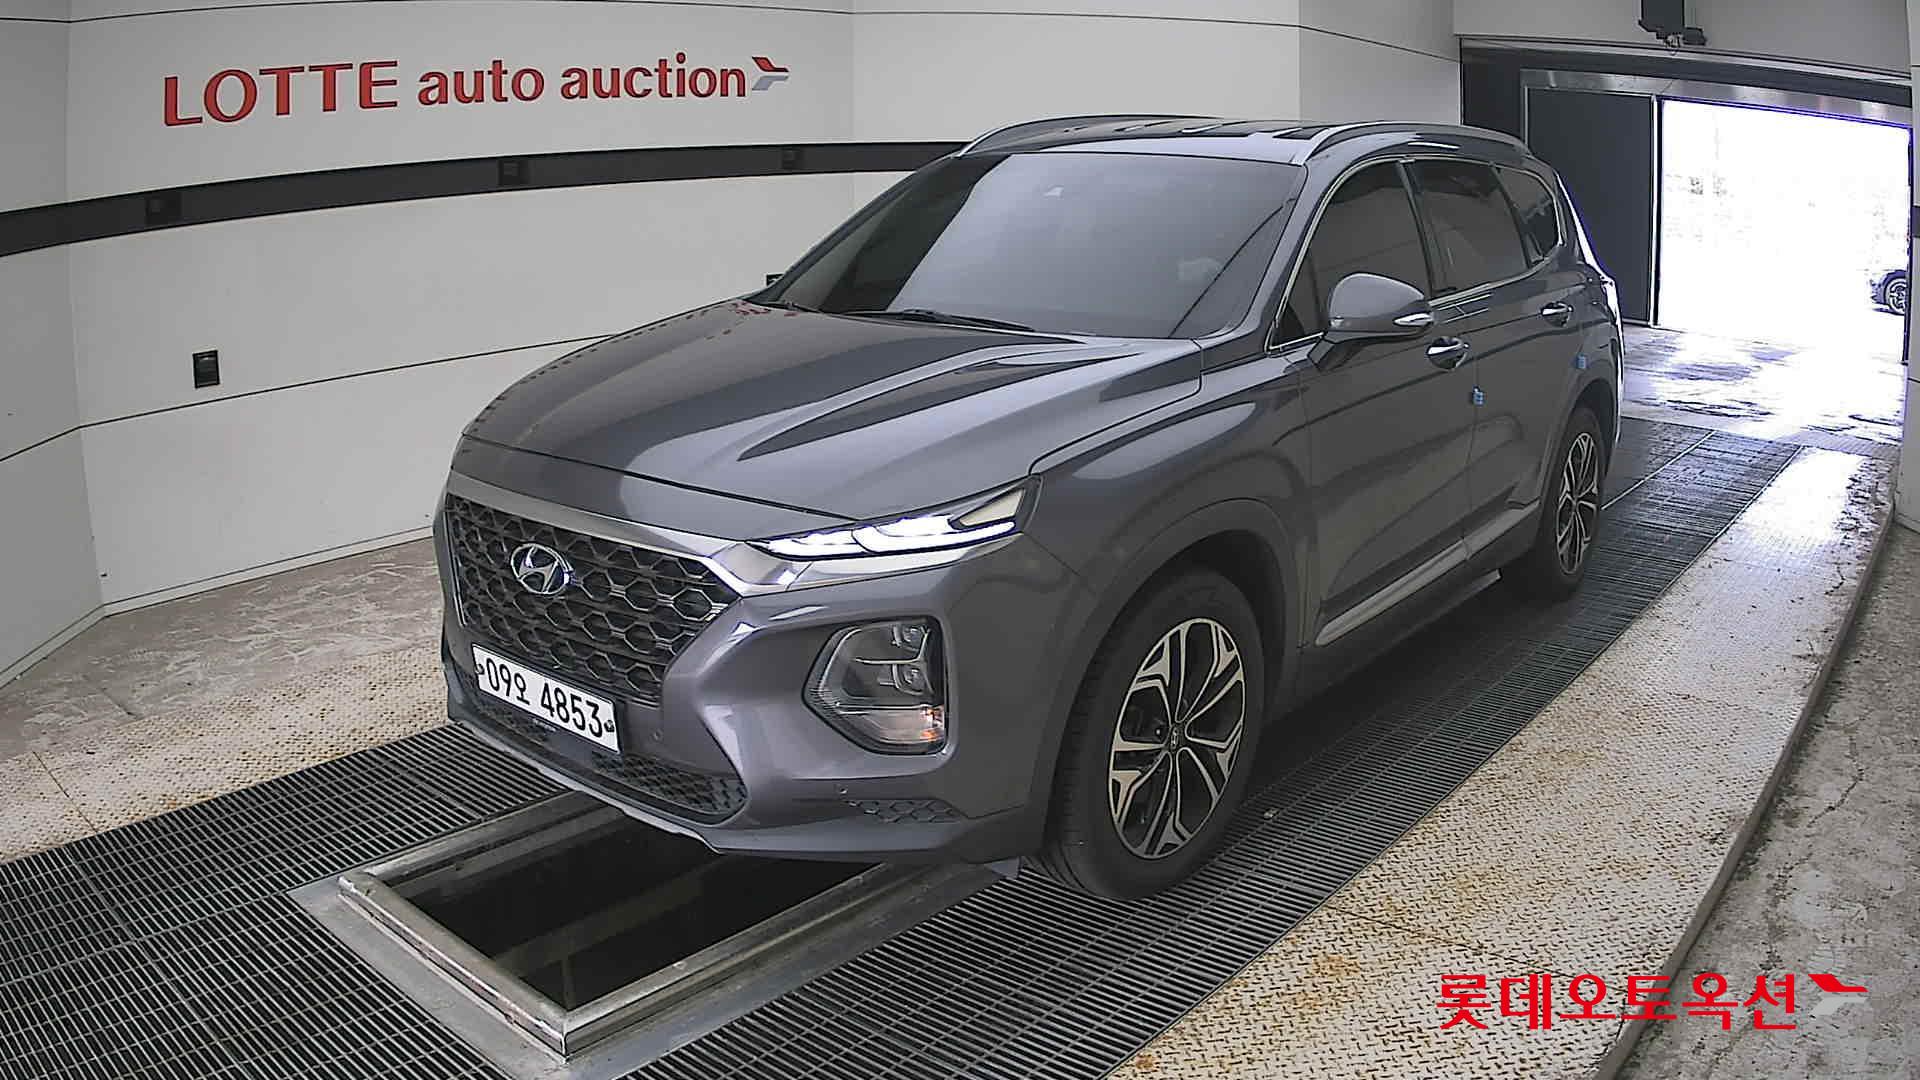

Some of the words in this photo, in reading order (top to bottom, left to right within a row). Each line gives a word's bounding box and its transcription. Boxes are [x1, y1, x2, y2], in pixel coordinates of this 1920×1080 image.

[164, 60, 398, 126] LOTTE
[417, 59, 545, 106] auto
[560, 51, 747, 100] auction
[486, 657, 530, 705] 09오
[540, 682, 603, 738] 4853
